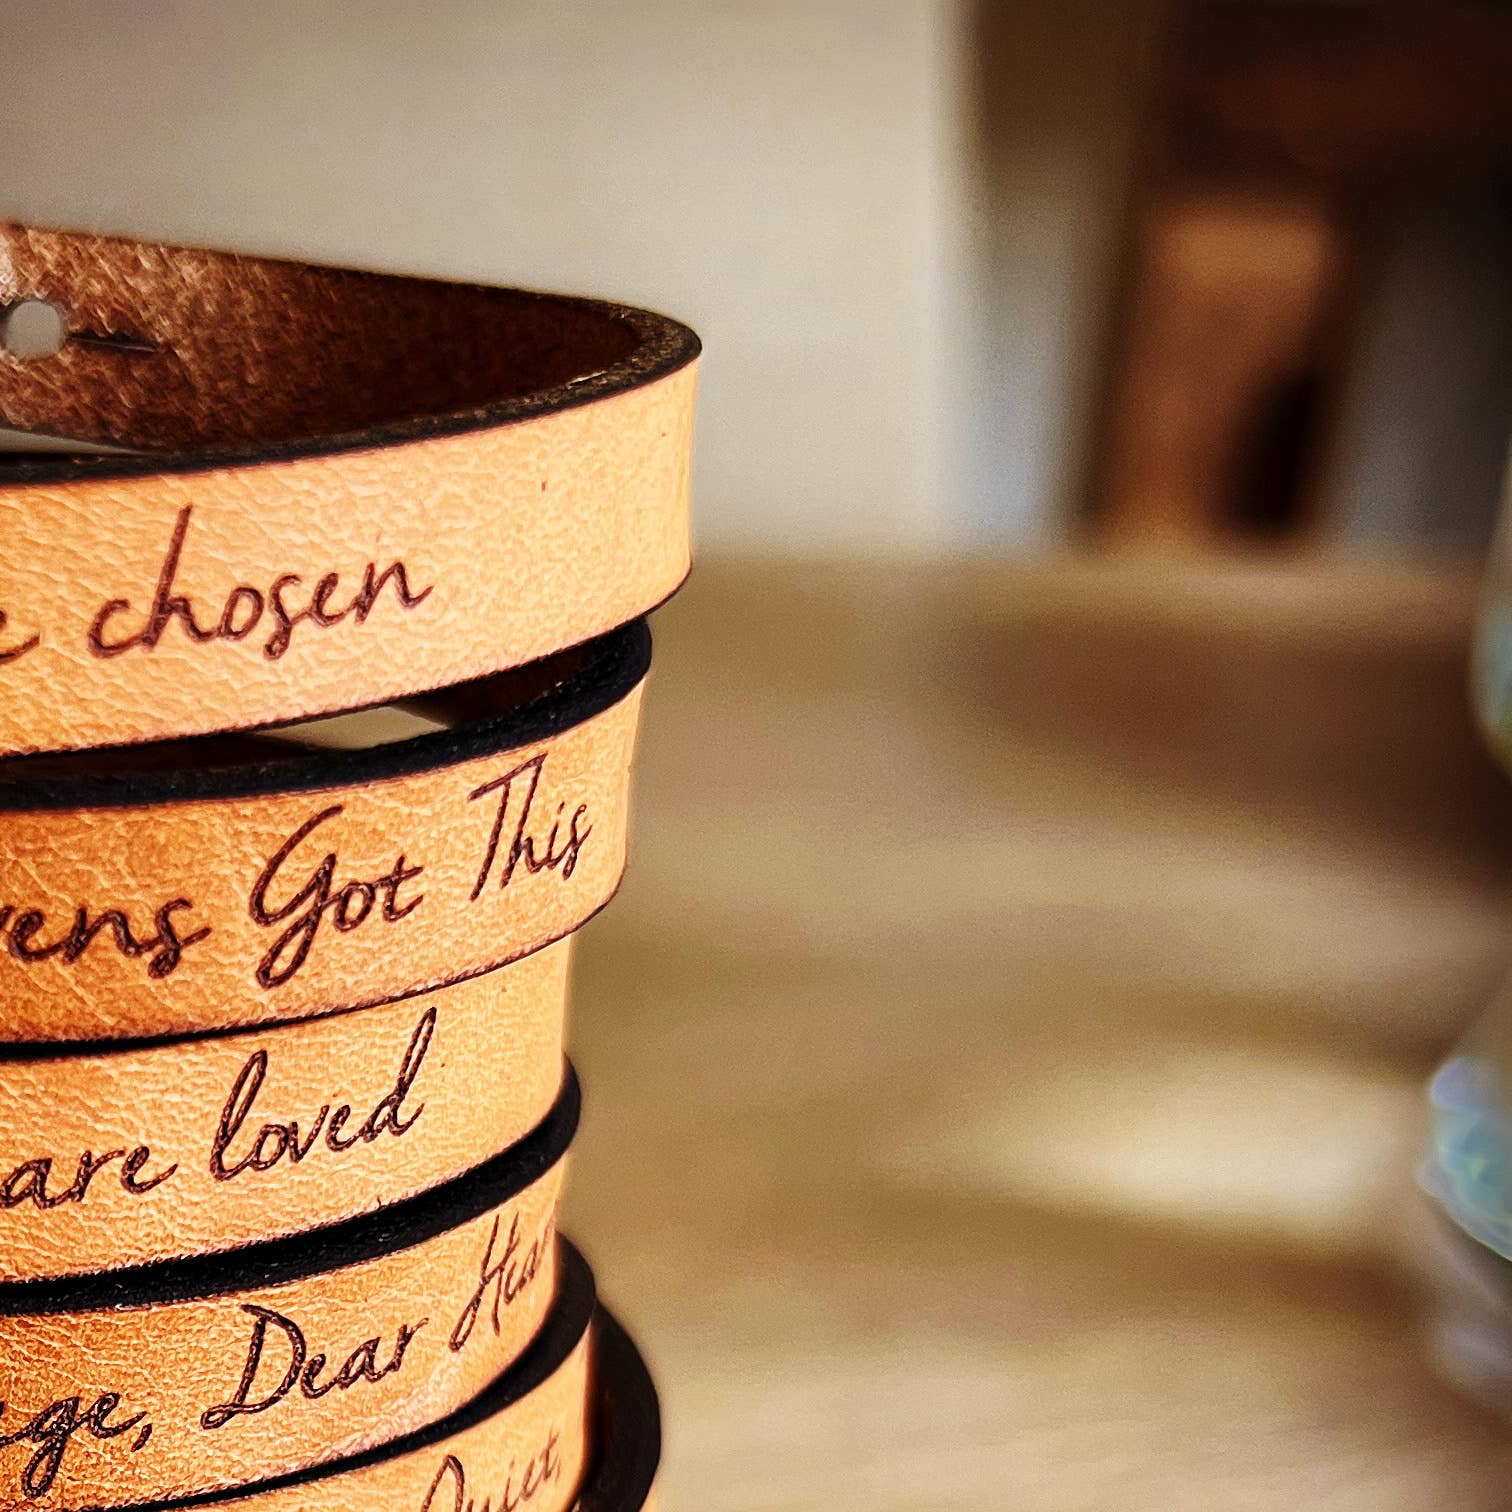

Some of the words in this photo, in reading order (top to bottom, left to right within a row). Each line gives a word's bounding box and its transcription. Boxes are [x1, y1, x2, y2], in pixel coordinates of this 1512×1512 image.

[87, 507, 432, 661] chosen
[248, 806, 424, 988] Got
[471, 754, 593, 902] This
[208, 1008, 437, 1182] loved
[201, 1305, 428, 1430] Dear
